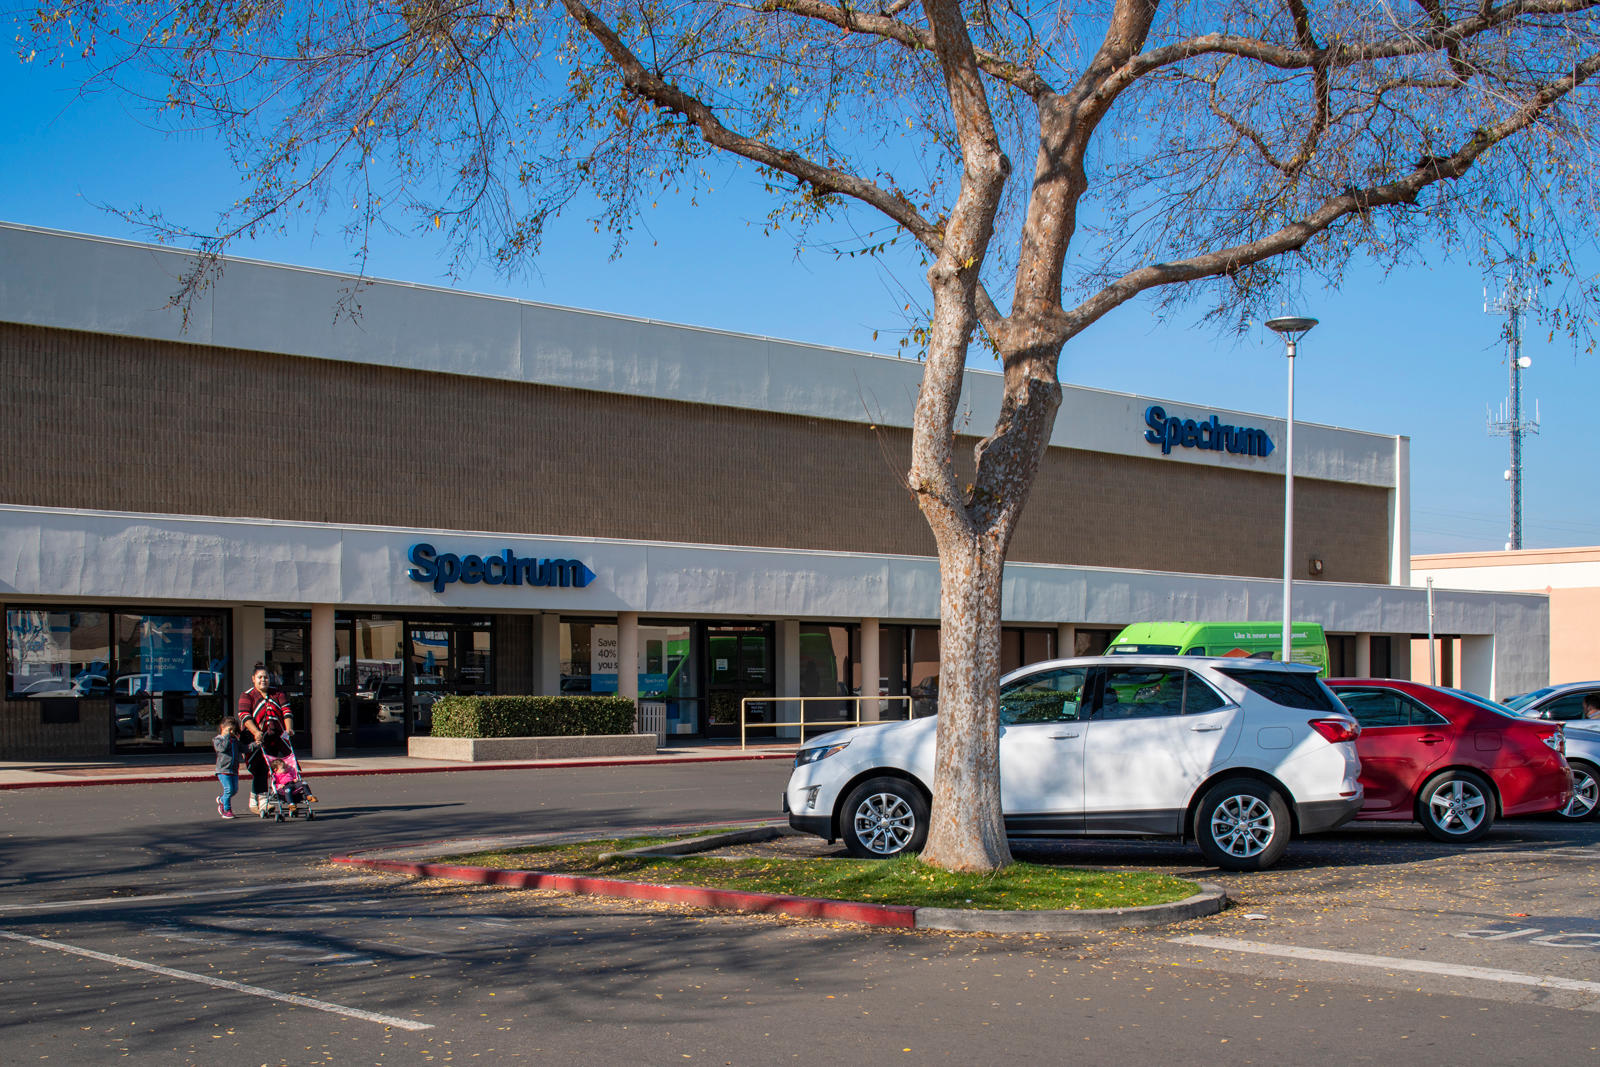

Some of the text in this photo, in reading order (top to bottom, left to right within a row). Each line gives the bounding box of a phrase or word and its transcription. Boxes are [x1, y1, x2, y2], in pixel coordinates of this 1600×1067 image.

[1144, 405, 1270, 456] Spectrum
[408, 543, 588, 593] Spectrum
[598, 638, 617, 647] Save
[598, 649, 617, 658] 40%
[598, 662, 612, 671] you
